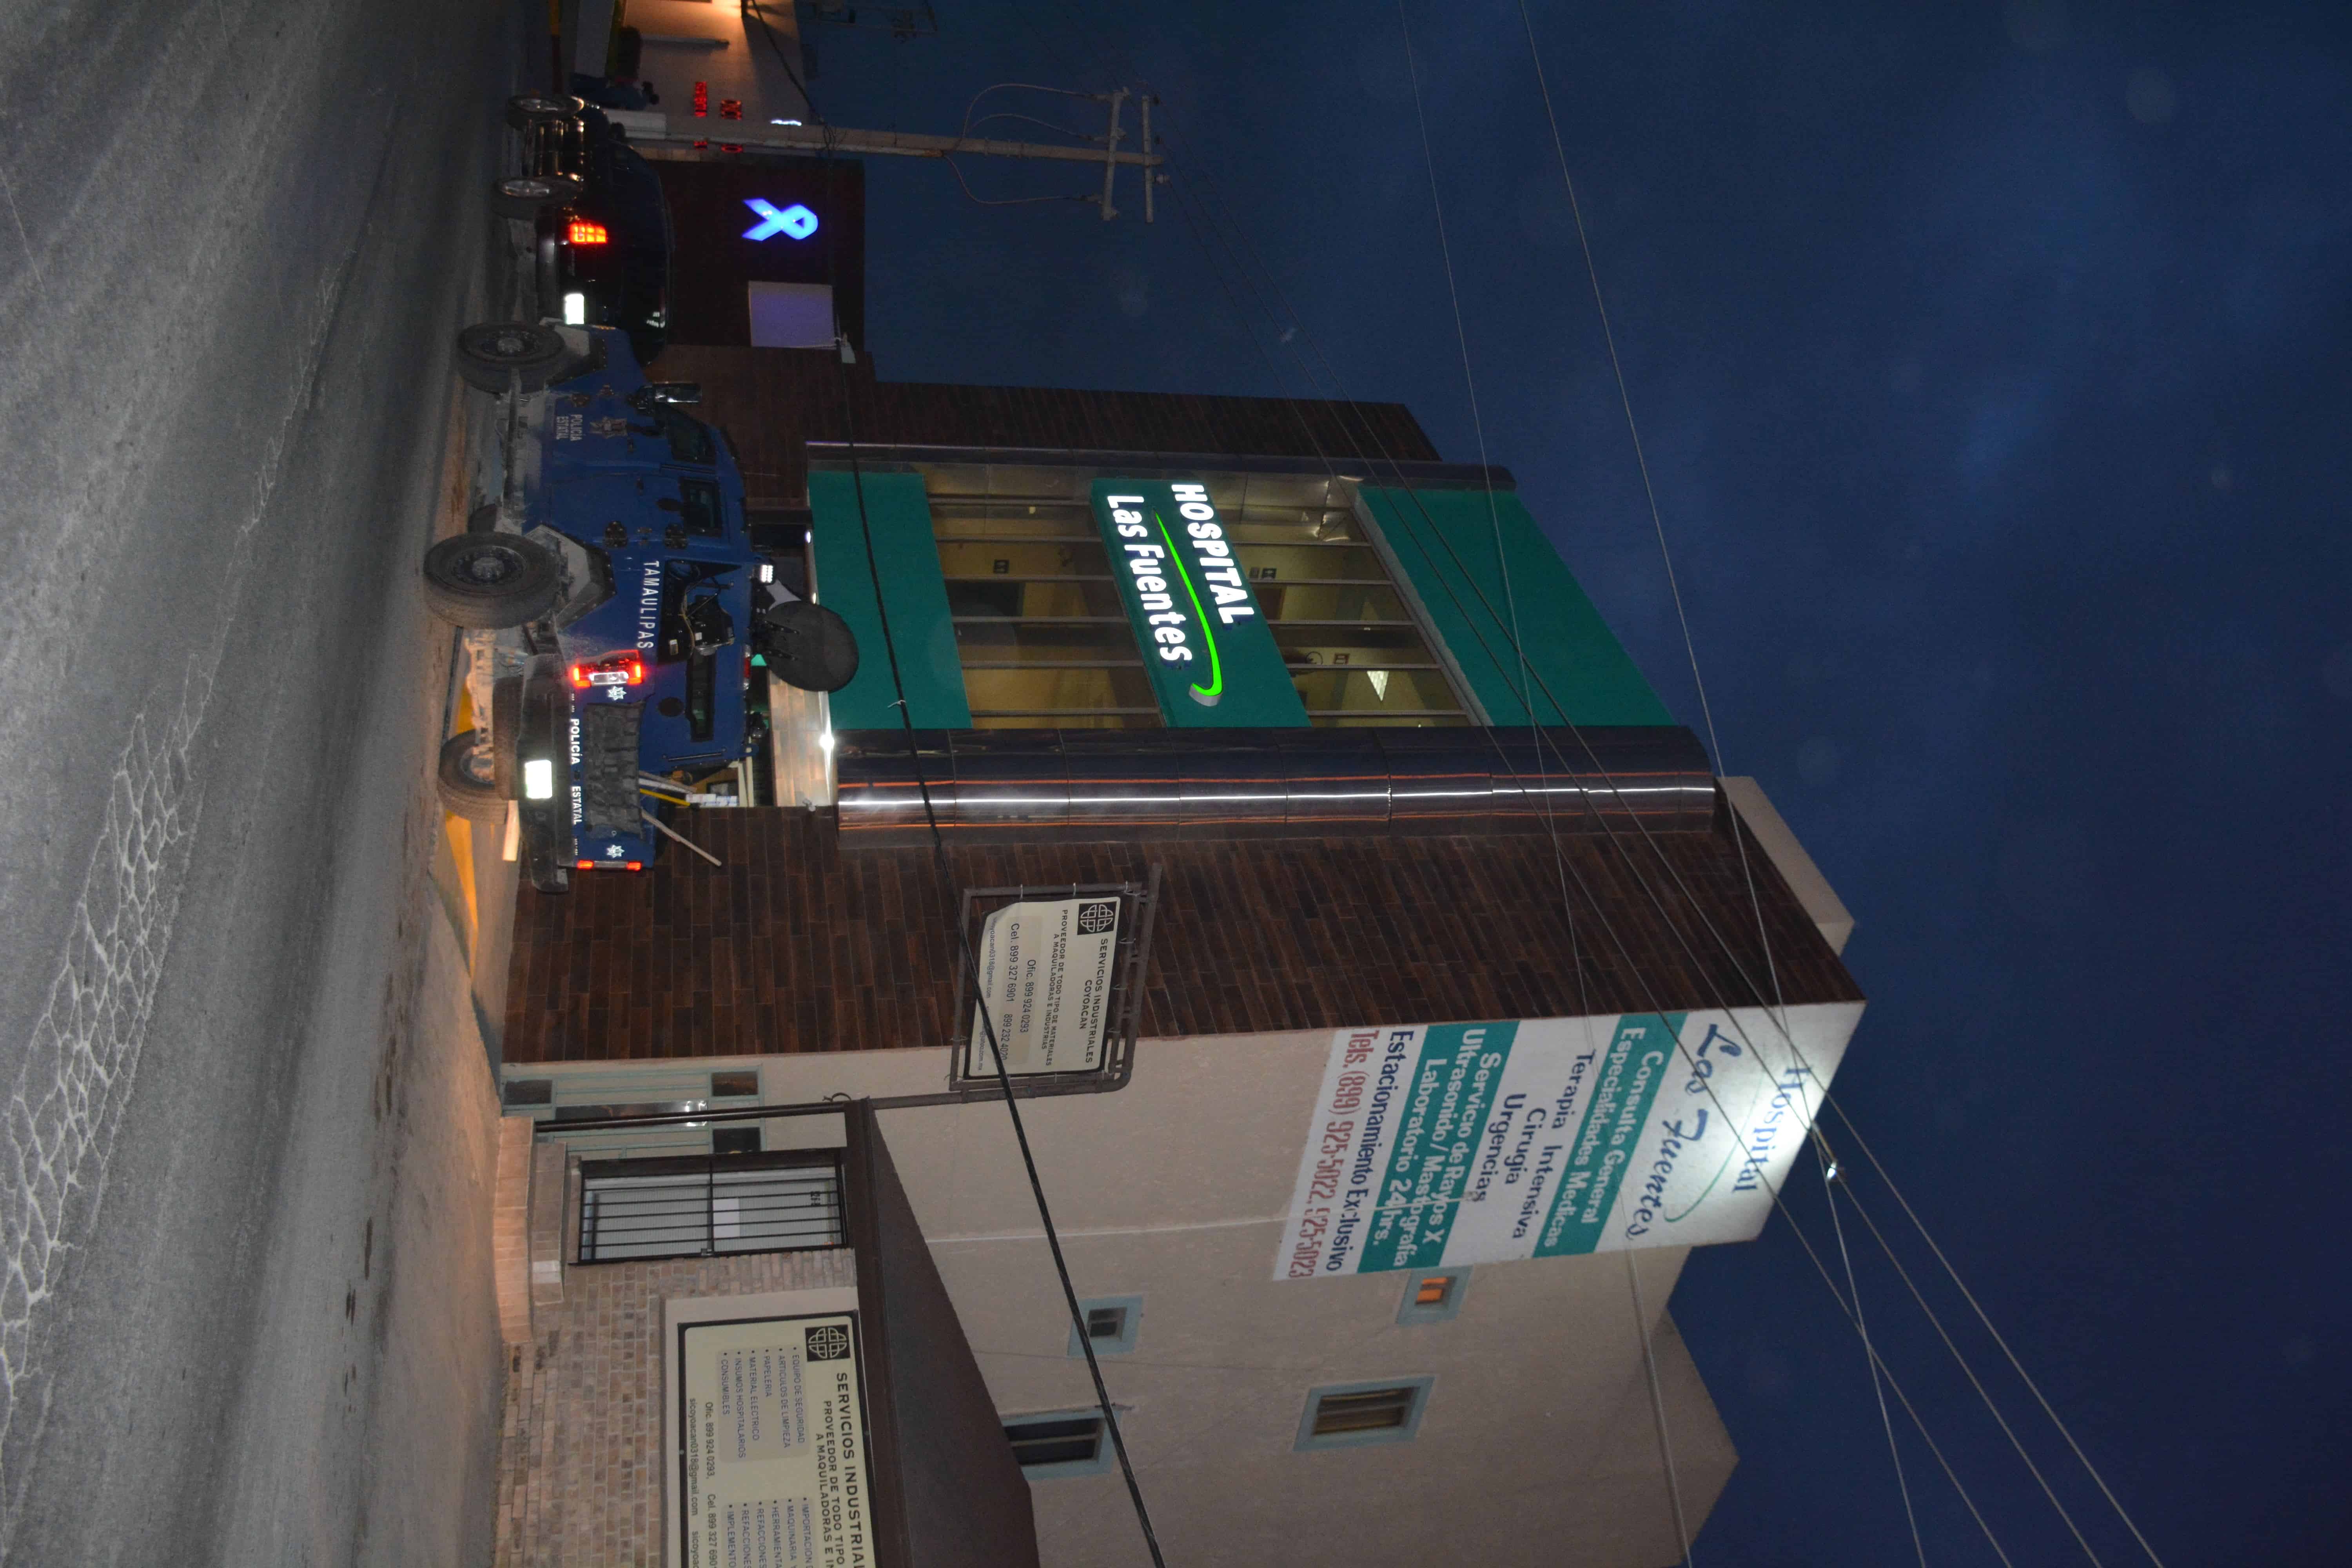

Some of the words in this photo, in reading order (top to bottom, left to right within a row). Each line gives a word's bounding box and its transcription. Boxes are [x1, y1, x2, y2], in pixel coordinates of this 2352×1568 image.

[556, 416, 569, 439] ESTATAL
[570, 414, 586, 441] POLICÍA
[1107, 495, 1148, 537] Las
[1172, 484, 1254, 624] HOSPITAL
[636, 561, 660, 649] TAMAULIPAS
[1124, 544, 1193, 662] Fuentes
[571, 719, 583, 764] POLICÍA
[572, 786, 582, 825] ESTATAL
[1010, 924, 1020, 942] Cel.
[1059, 909, 1068, 959] PROVEEDOR
[1008, 965, 1017, 980] 327
[1009, 946, 1019, 962] 899
[1025, 960, 1036, 979] Ofic.
[1047, 942, 1059, 1001] MAQUILADORAS
[1058, 962, 1064, 972] DE
[1095, 938, 1108, 992] SERVICIOS
[1006, 984, 1016, 1002] 6901
[1022, 998, 1032, 1013] 924
[1024, 982, 1034, 997] 899
[1079, 980, 1092, 1029] COYOACAN
[1001, 1029, 1011, 1041] 232
[1003, 1014, 1013, 1027] 899
[1020, 1013, 1030, 1033] 0293
[1042, 1010, 1053, 1049] INDUSTRIAS
[1052, 1014, 1059, 1024] DE
[1085, 995, 1101, 1063] INDUSTRIALES
[1045, 1026, 1056, 1066] MATERIALES
[1342, 1030, 1379, 1068] Tels.
[1686, 1024, 1742, 1095] Las
[1328, 1071, 1370, 1114] (899)
[1351, 1031, 1414, 1185] Estacionamiento
[1457, 1052, 1502, 1138] Servicio
[1551, 1049, 1596, 1129] Terapia
[1574, 1027, 1646, 1165] Especialidades
[1610, 1051, 1664, 1145] Consulta
[1395, 1059, 1447, 1172] Laboratorio
[1731, 1066, 1813, 1194] Hospital
[1450, 1142, 1470, 1163] de
[1472, 1094, 1526, 1202] Urgencias
[1504, 1108, 1546, 1184] Cirugia
[1384, 1179, 1412, 1207] 24
[1429, 1165, 1465, 1225] Rayos
[1512, 1145, 1563, 1238] Intensiva
[1581, 1149, 1626, 1224] General
[1626, 1109, 1708, 1241] Fuentes
[1373, 1210, 1402, 1245] hrs.
[1544, 1171, 1590, 1247] Medicas
[1422, 1229, 1445, 1244] X
[721, 1359, 730, 1415] CONSUMIBLES
[735, 1358, 743, 1393] INSUMOS
[749, 1357, 757, 1394] MATERIAL
[764, 1356, 772, 1397] PAPELERIA
[779, 1355, 787, 1397] ARTICULOS
[792, 1355, 800, 1383] EQUIPO
[781, 1399, 788, 1409] DE
[794, 1386, 801, 1395] DE
[736, 1395, 746, 1458] HOSPITALARIOS
[751, 1396, 760, 1441] ELECTRICO
[781, 1412, 791, 1448] LIMPIEZA
[795, 1398, 805, 1443] SEGURIDAD
[824, 1401, 837, 1471] PROVEEDOR
[837, 1372, 855, 1459] SERVICIOS
[706, 1439, 714, 1454] 924
[708, 1494, 716, 1510] Cel.
[818, 1445, 832, 1542] MAQUILADORAS
[830, 1477, 838, 1491] DE
[708, 1514, 717, 1528] 899
[787, 1505, 797, 1561] MAQUINARIA
[802, 1504, 812, 1563] IMPORTACION
[832, 1497, 842, 1530] TODO
[709, 1531, 717, 1546] 327
[835, 1536, 845, 1564] TIPO
